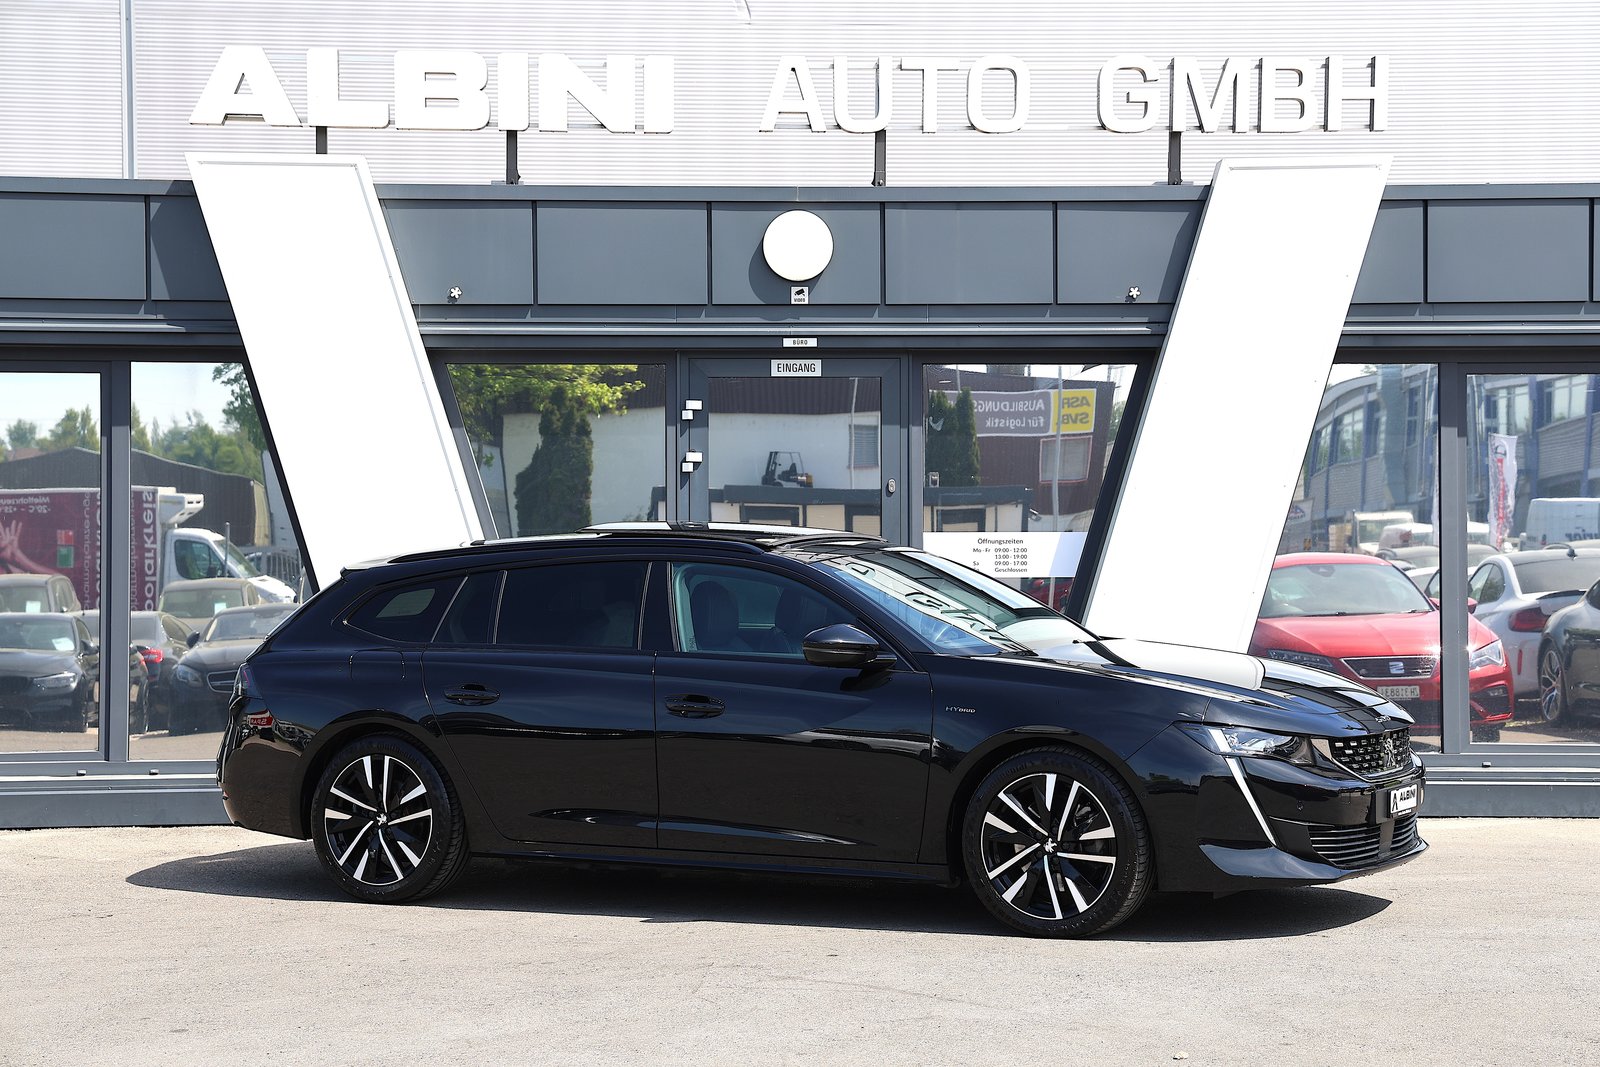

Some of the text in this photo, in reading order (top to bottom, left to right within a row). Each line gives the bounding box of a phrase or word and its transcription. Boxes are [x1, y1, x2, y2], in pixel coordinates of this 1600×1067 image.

[189, 44, 1391, 135] ALBINI AUTO GMBH
[792, 338, 808, 346] BÜRO
[776, 362, 816, 373] EINGANG
[977, 537, 1024, 545] Öffnungszeiten
[945, 705, 976, 713] HYBRID
